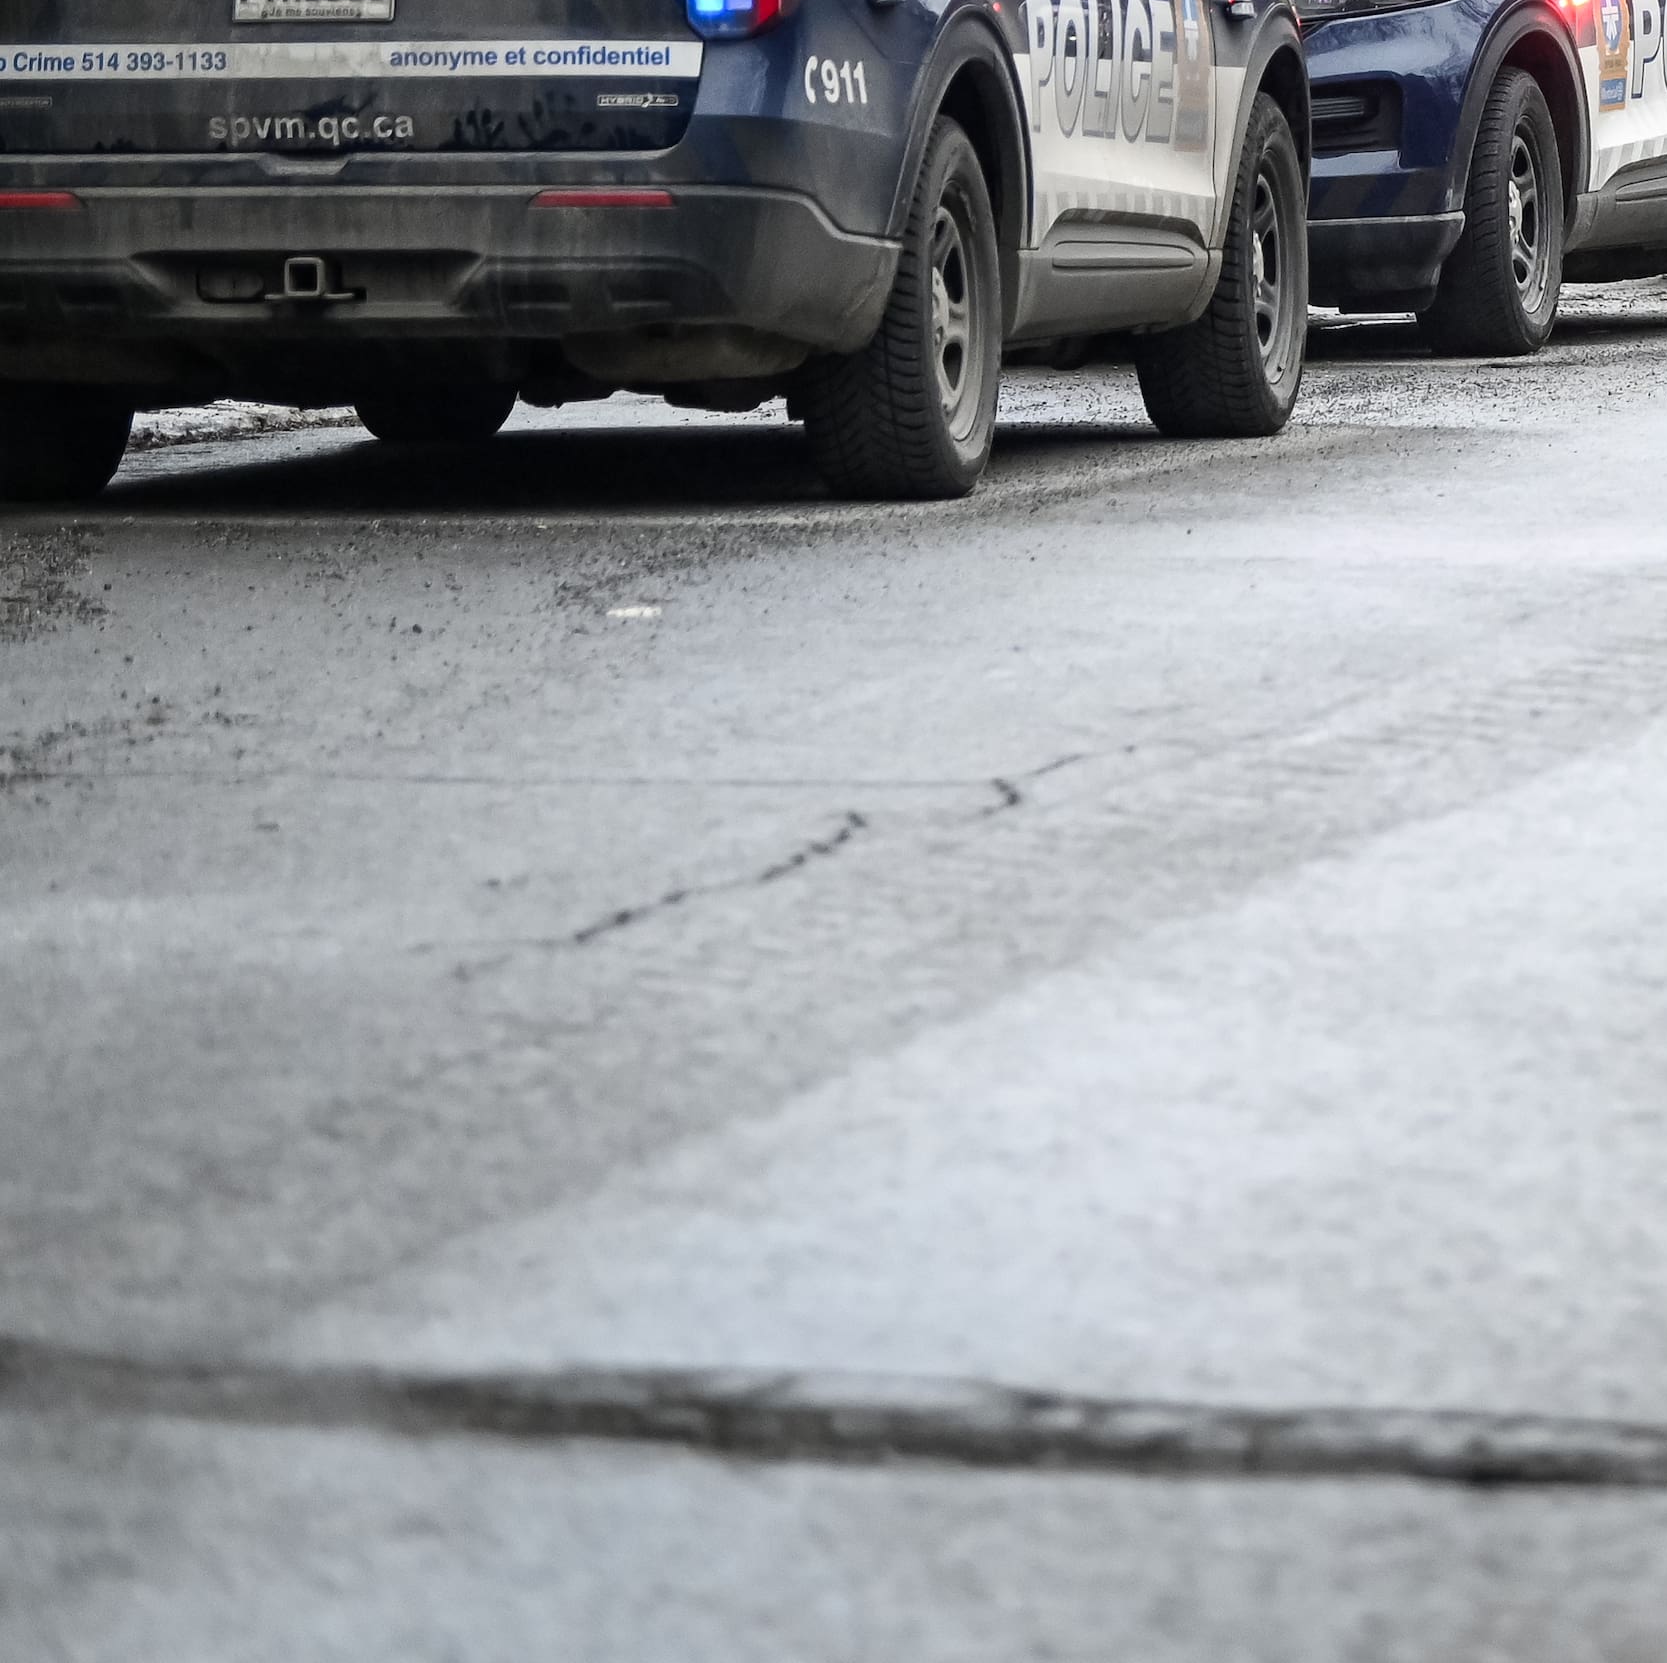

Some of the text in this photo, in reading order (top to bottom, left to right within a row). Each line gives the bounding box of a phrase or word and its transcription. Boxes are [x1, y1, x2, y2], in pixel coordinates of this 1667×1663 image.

[13, 52, 75, 72] Crime
[82, 52, 119, 71] 514
[127, 51, 227, 71] 393-1133
[390, 44, 671, 72] anonyme et confidentiel
[821, 59, 868, 104] 911
[209, 111, 414, 145] spvm.qc.ca
